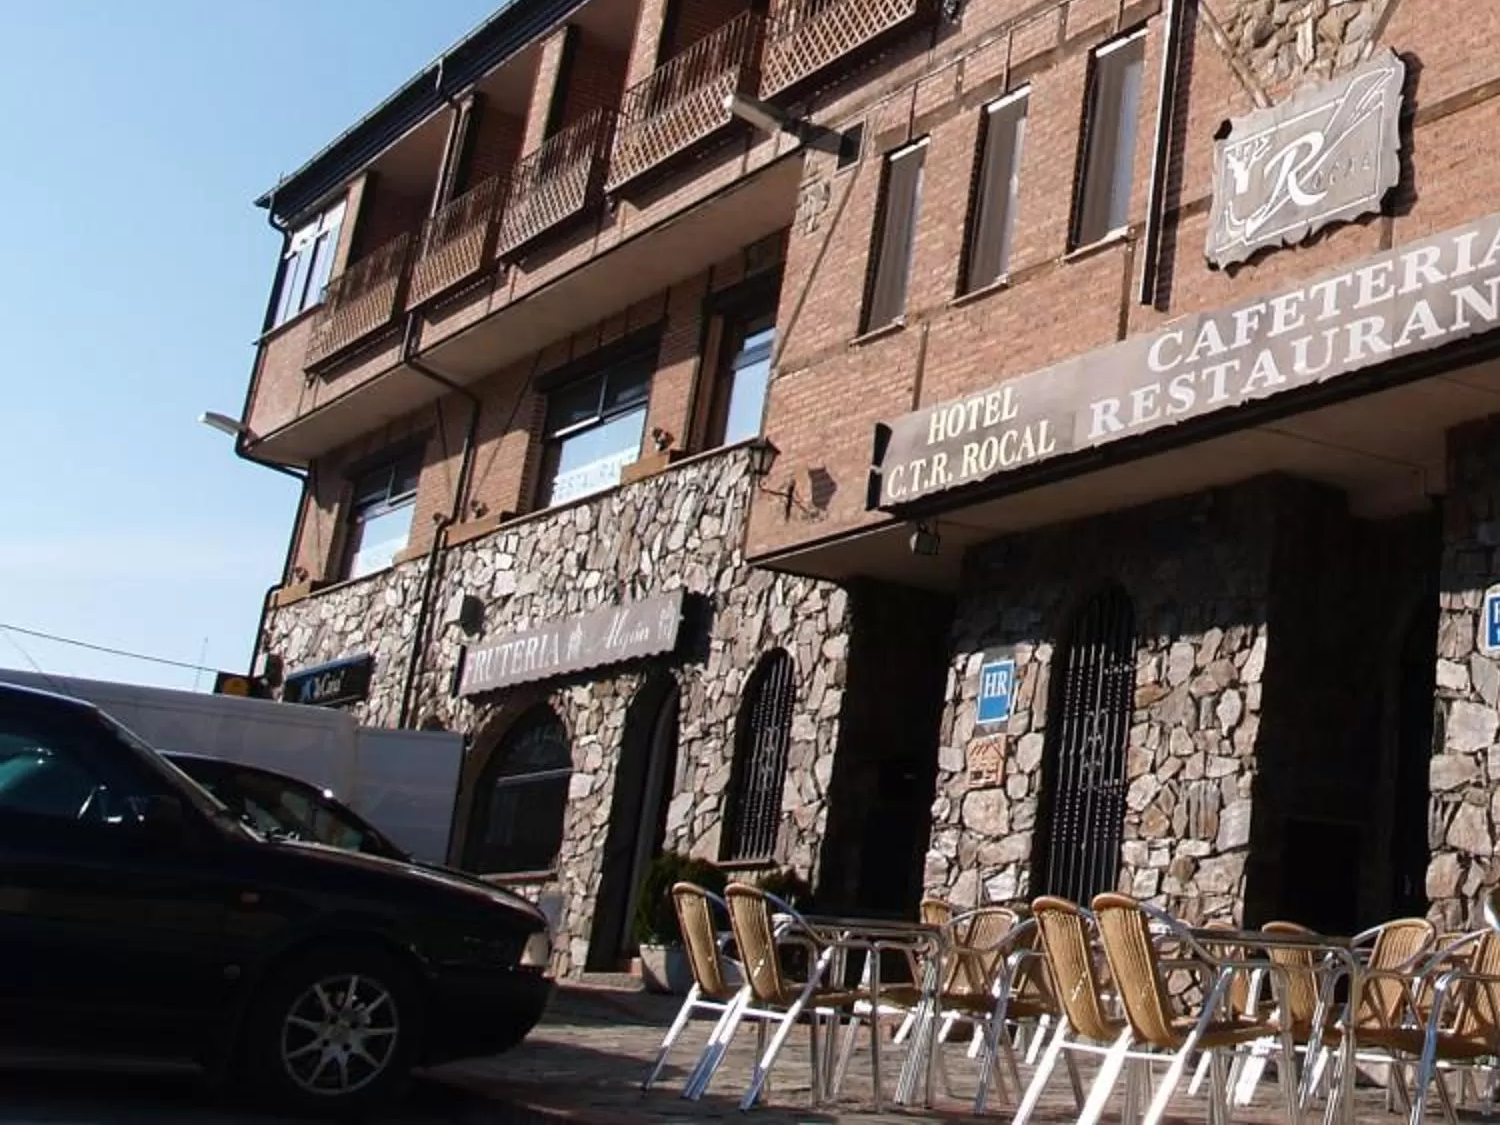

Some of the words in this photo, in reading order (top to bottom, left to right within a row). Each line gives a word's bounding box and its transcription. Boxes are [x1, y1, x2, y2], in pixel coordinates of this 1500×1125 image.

[926, 386, 1019, 445] HOTEL
[887, 451, 953, 498] C.T.R.
[960, 419, 1056, 477] ROCAL
[460, 632, 559, 686] FRUTERIA
[984, 670, 1007, 699] HR
